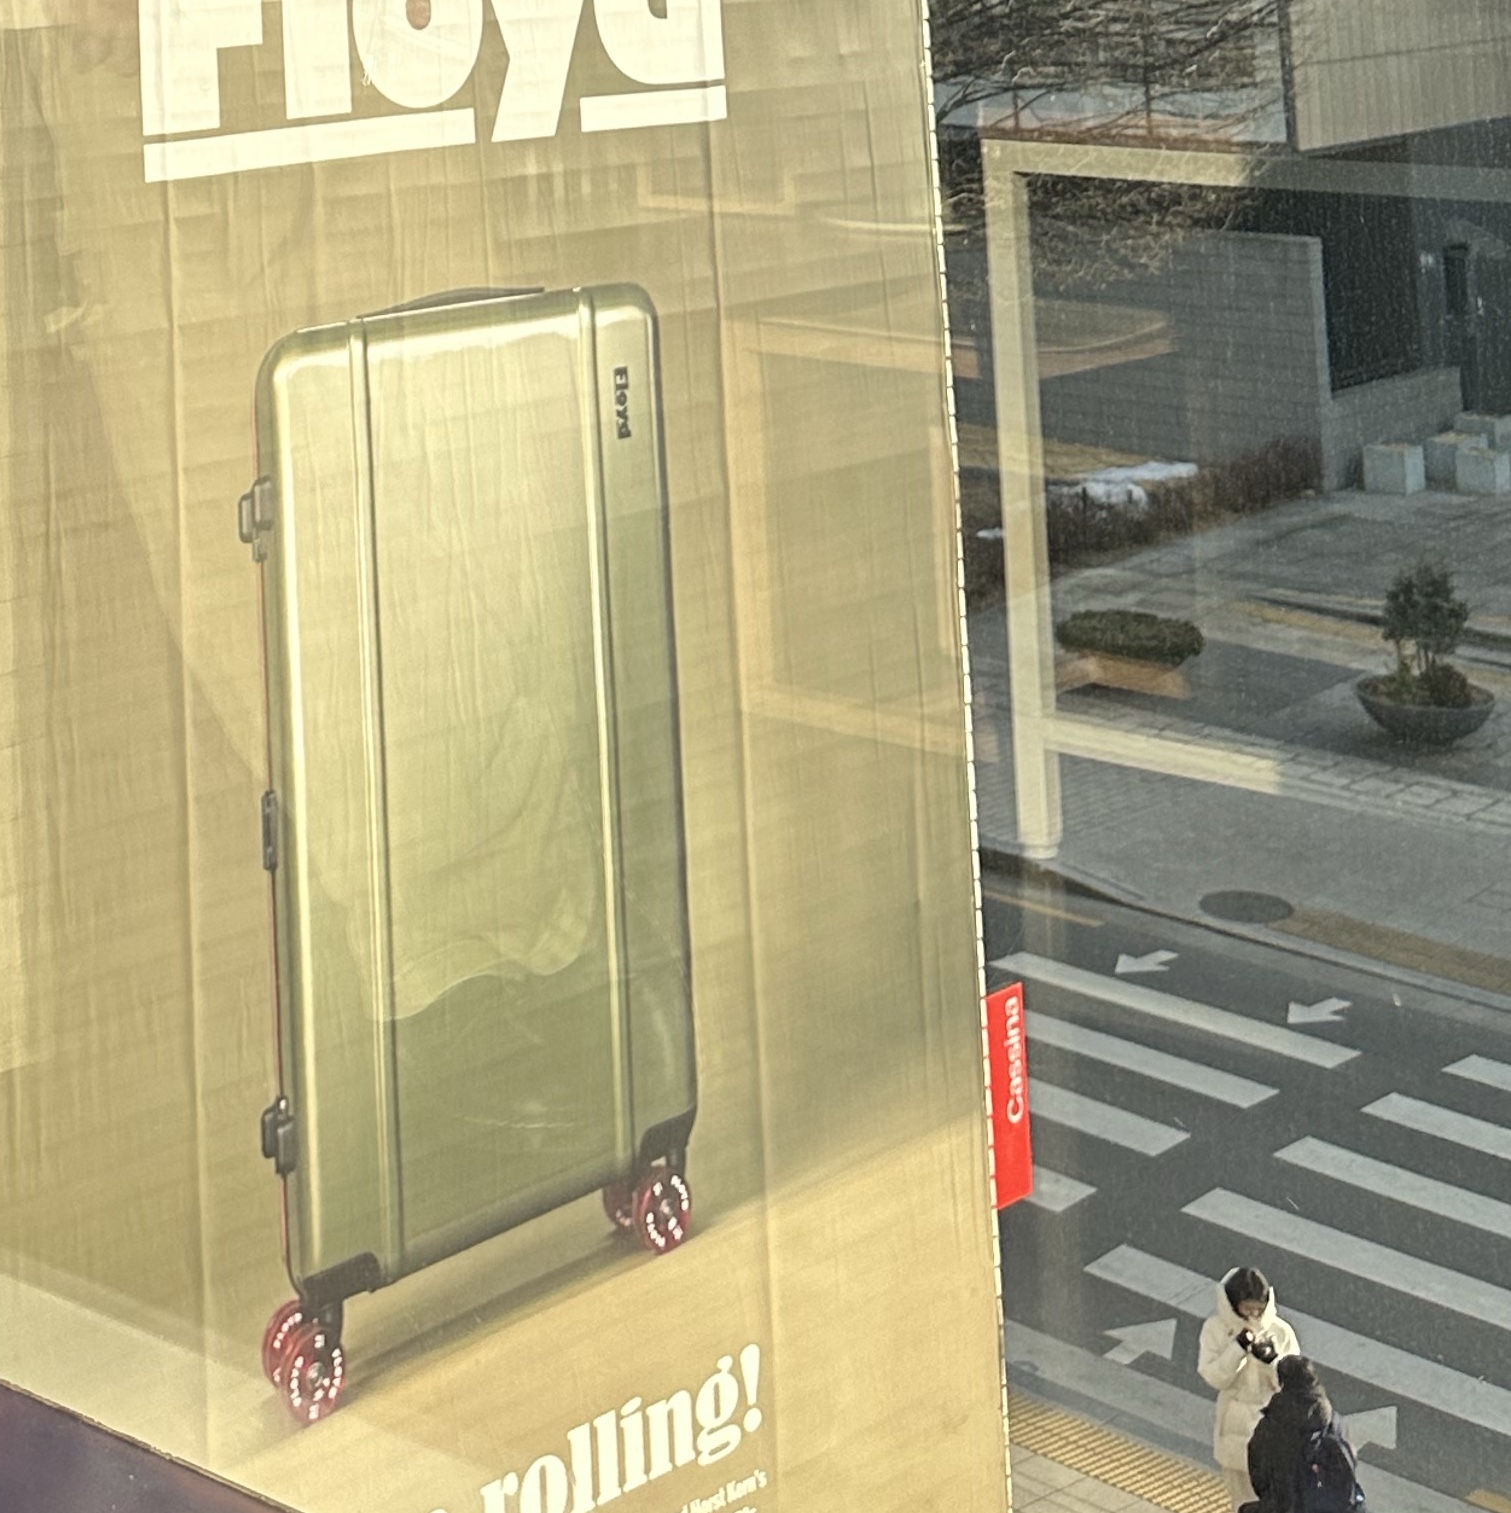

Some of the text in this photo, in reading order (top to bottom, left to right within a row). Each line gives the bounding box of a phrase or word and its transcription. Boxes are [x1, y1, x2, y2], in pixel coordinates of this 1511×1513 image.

[614, 366, 632, 439] Floyd
[1004, 996, 1024, 1123] Cassina
[480, 1343, 763, 1513] rolling!
